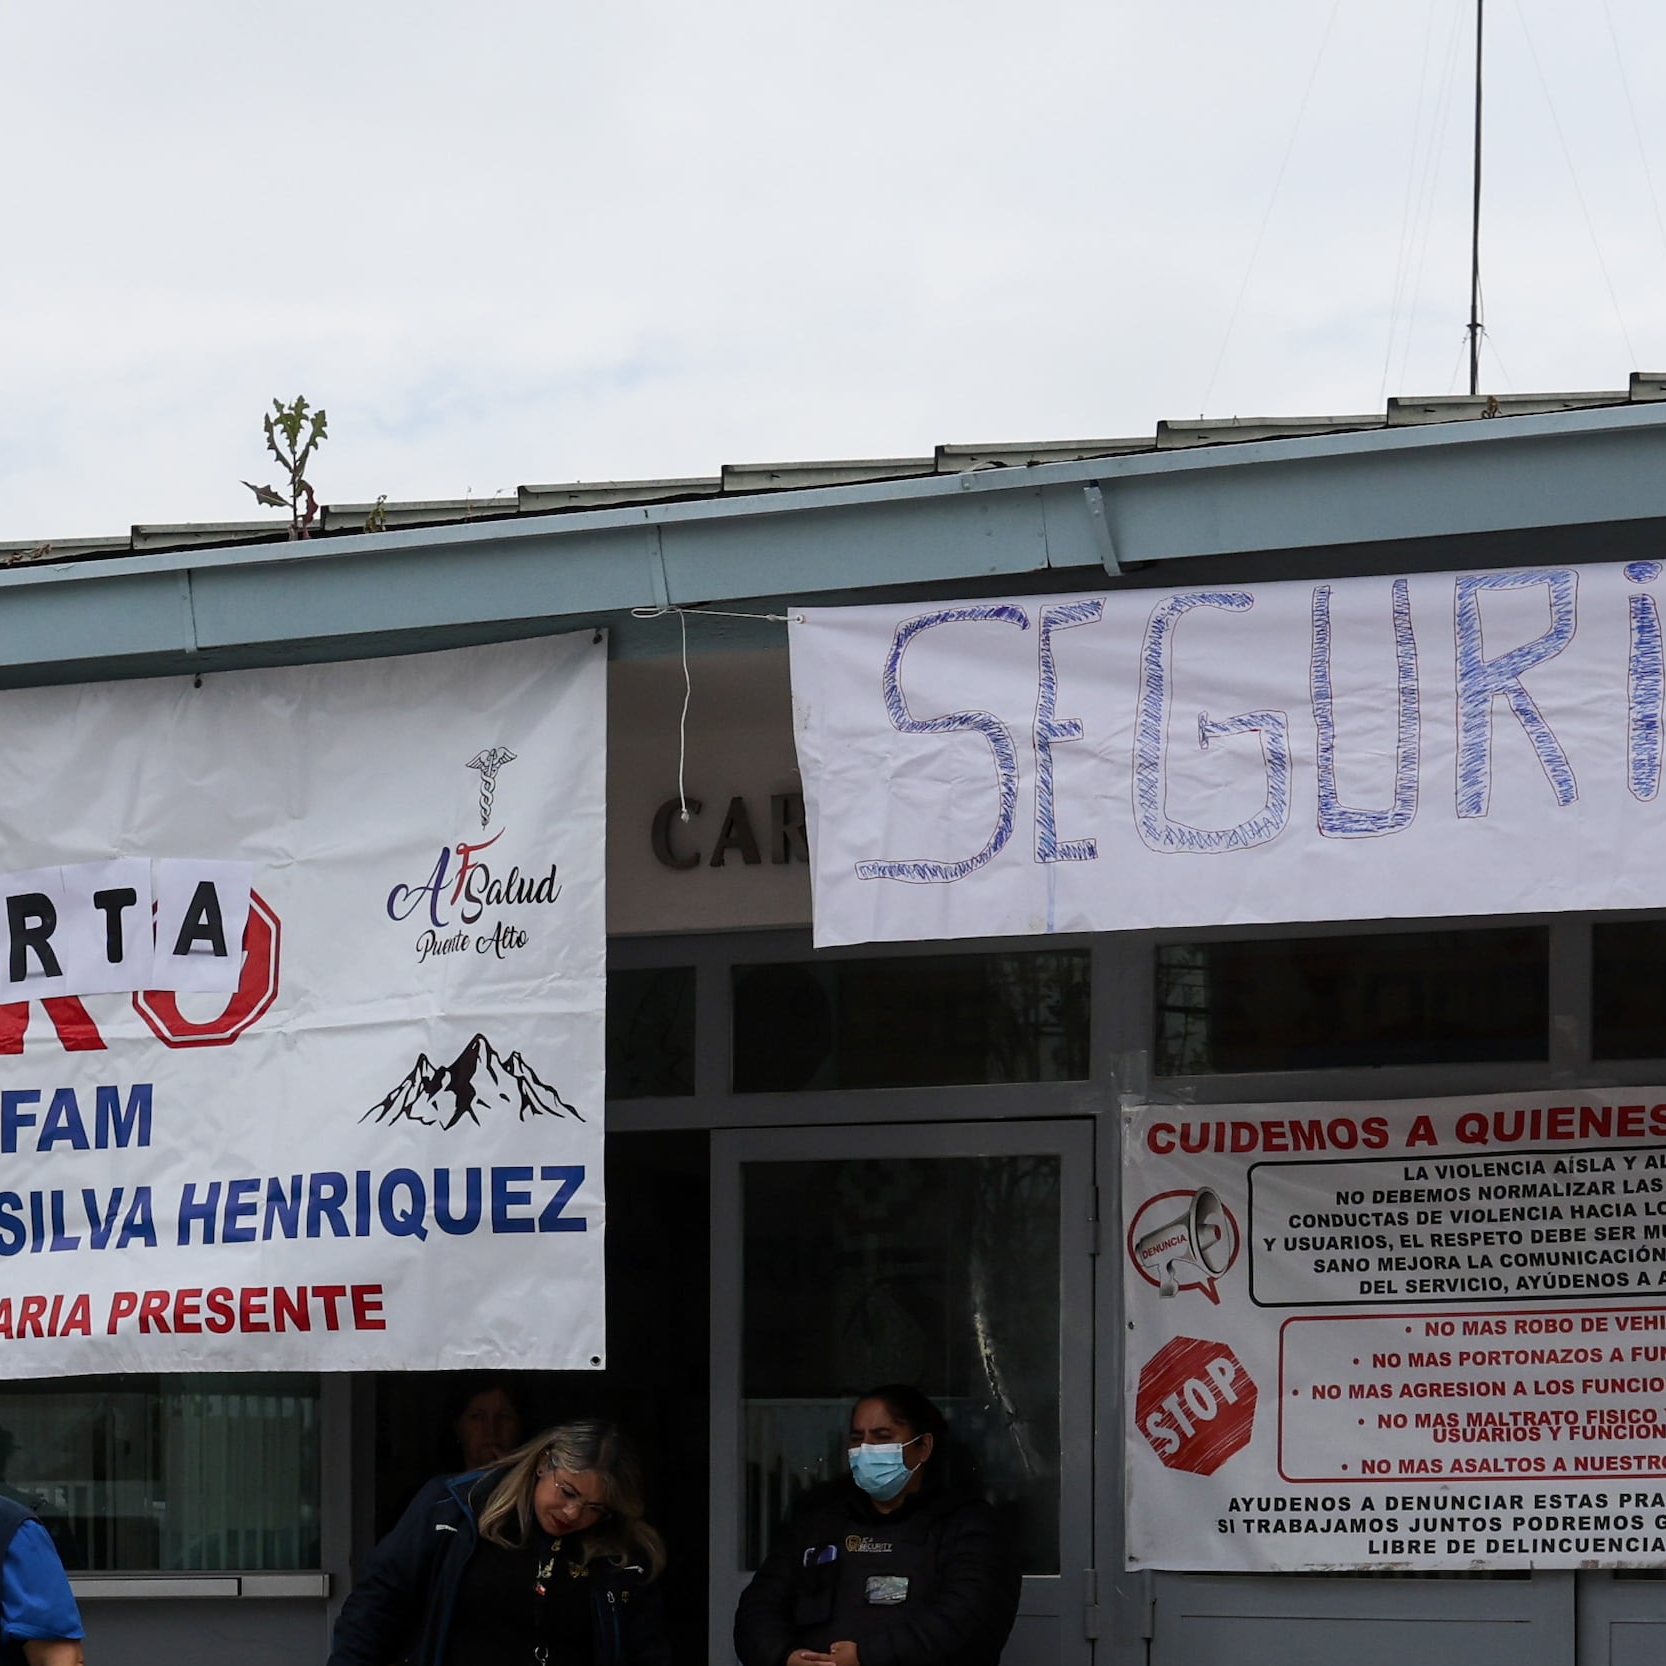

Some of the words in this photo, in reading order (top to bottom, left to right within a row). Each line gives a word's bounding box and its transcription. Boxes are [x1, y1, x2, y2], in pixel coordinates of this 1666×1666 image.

[461, 863, 563, 925] Salud
[416, 928, 470, 964] Puente
[475, 921, 530, 960] Alto
[1146, 1116, 1389, 1155] CUIDEMOS
[1405, 1115, 1438, 1148] A
[1404, 1165, 1429, 1182] LA
[1435, 1160, 1546, 1181] VIOLENCIA
[1554, 1157, 1616, 1177] AÍSLA
[1622, 1155, 1638, 1171] Y
[1336, 1190, 1365, 1206] NO
[1372, 1187, 1471, 1205] DEBEMOS
[1478, 1179, 1616, 1202] NORMALIZAR
[1622, 1177, 1664, 1196] LAS
[177, 1165, 587, 1246] HENRIQUEZ
[1288, 1211, 1409, 1229] CONDUCTAS
[1416, 1209, 1443, 1227] DE
[1449, 1205, 1564, 1224] VIOLENCIA
[1570, 1202, 1638, 1220] HACIA
[1141, 1233, 1188, 1260] DENUNCIA
[1263, 1237, 1277, 1252] Y
[1284, 1234, 1395, 1254] USUARIOS,
[1399, 1234, 1425, 1249] EL
[1430, 1230, 1523, 1248] RESPETO
[1530, 1227, 1587, 1244] DEBE
[1593, 1225, 1637, 1242] SER
[1313, 1258, 1370, 1274] SANO
[1377, 1255, 1462, 1272] MEJORA
[1467, 1254, 1494, 1269] LA
[1499, 1244, 1666, 1268] COMUNICACIÓN
[1359, 1280, 1398, 1295] DEL
[1405, 1276, 1509, 1295] SERVICIO,
[1515, 1271, 1630, 1290] AYÚDENOS
[1636, 1271, 1651, 1286] A
[107, 1284, 386, 1335] PRESENTE
[1425, 1321, 1455, 1337] NO
[1462, 1320, 1507, 1336] MAS
[1514, 1318, 1574, 1335] ROBO
[1581, 1317, 1608, 1333] DE
[1372, 1353, 1401, 1368] NO
[1408, 1352, 1452, 1368] MAS
[1459, 1348, 1603, 1367] PORTONAZOS
[1609, 1347, 1624, 1363] A
[1312, 1384, 1341, 1400] NO
[1349, 1383, 1393, 1399] MAS
[1399, 1381, 1506, 1398] AGRESION
[1513, 1380, 1527, 1396] A
[1534, 1379, 1575, 1395] LOS
[1146, 1356, 1239, 1455] STOP
[1378, 1413, 1408, 1429] NO
[1415, 1412, 1461, 1429] MAS
[1466, 1410, 1579, 1428] MALTRATO
[1586, 1408, 1658, 1426] FISICO
[1433, 1426, 1541, 1443] USUARIOS
[1547, 1426, 1562, 1441] Y
[1361, 1459, 1391, 1474] NO
[1398, 1458, 1443, 1474] MAS
[1450, 1457, 1546, 1473] ASALTOS
[1552, 1457, 1567, 1472] A
[1228, 1496, 1351, 1512] AYUDENOS
[1360, 1496, 1375, 1511] A
[1385, 1495, 1524, 1511] DENUNCIAR
[1534, 1493, 1608, 1510] ESTAS
[1217, 1518, 1235, 1534] SI
[1242, 1517, 1399, 1534] TRABAJAMOS
[1408, 1517, 1502, 1533] JUNTOS
[1513, 1514, 1644, 1532] PODREMOS
[1368, 1539, 1436, 1555] LIBRE
[1447, 1539, 1476, 1554] DE
[1486, 1537, 1666, 1554] DELINCUENCIA
